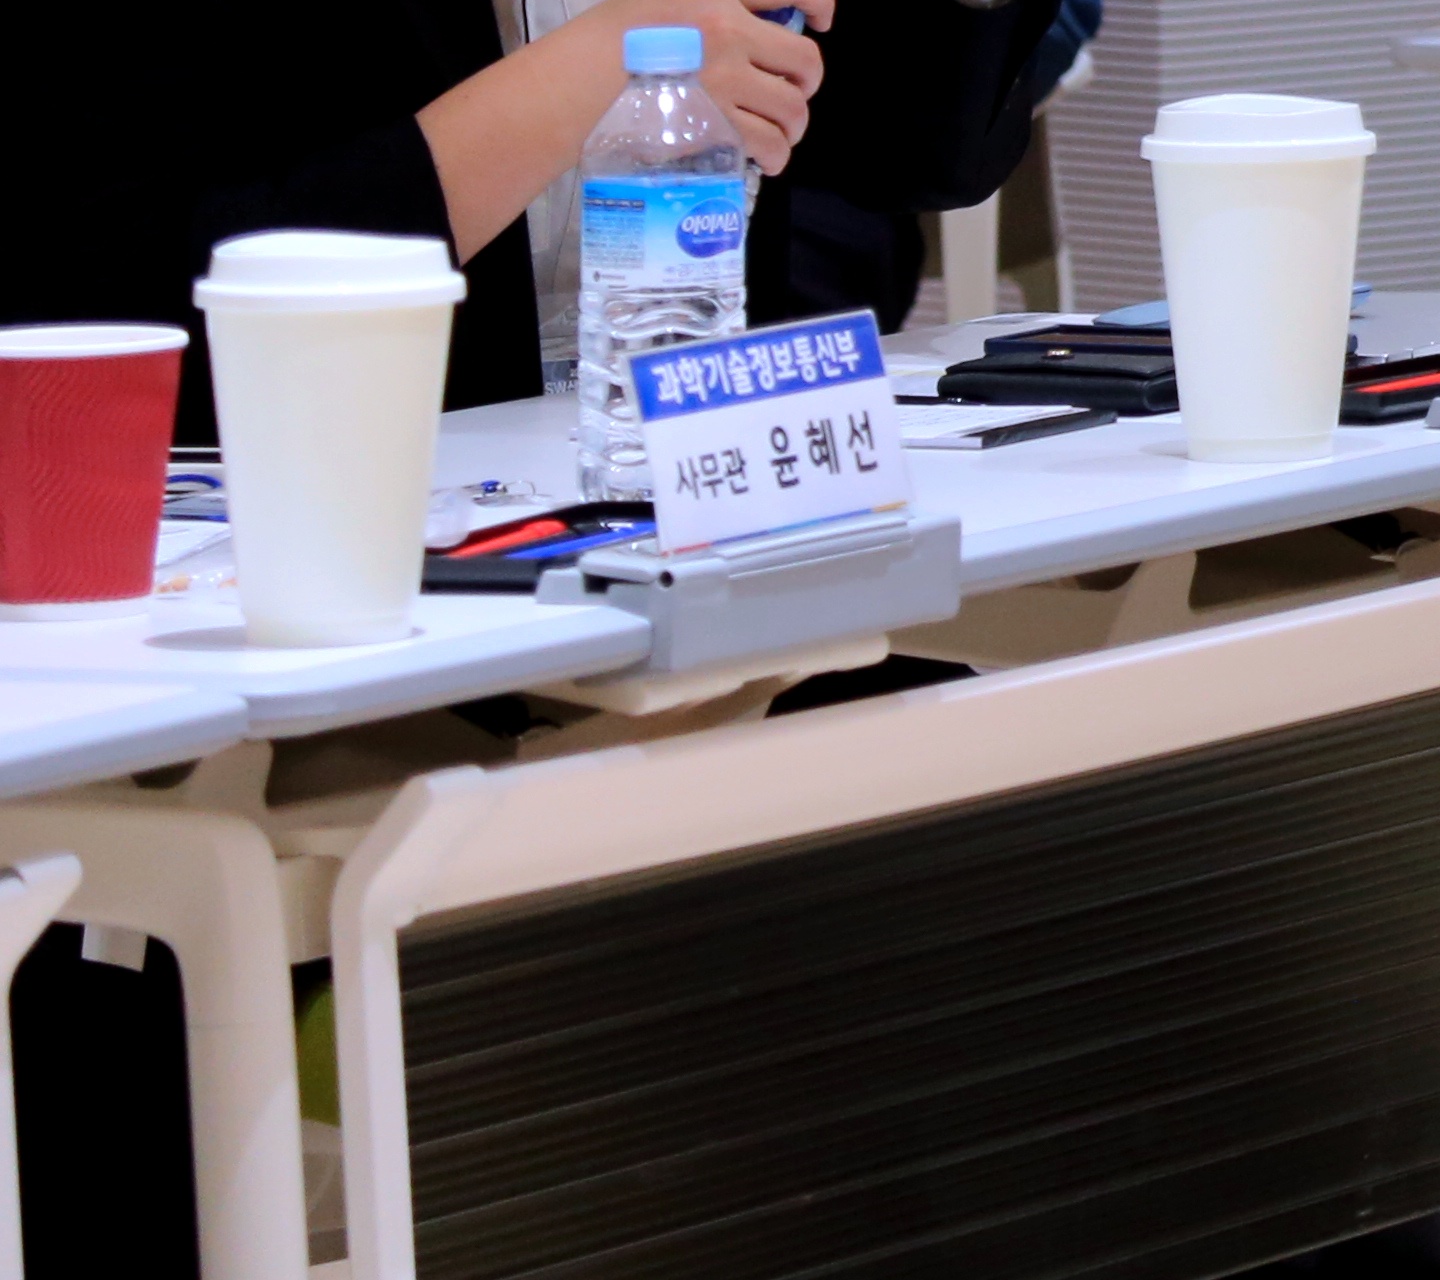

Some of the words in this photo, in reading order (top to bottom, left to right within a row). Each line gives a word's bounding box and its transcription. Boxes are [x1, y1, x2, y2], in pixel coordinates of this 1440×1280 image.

[651, 329, 861, 404] 과학기술정보통신부
[676, 447, 749, 500] 사무관
[770, 410, 878, 489] 윤혜선
